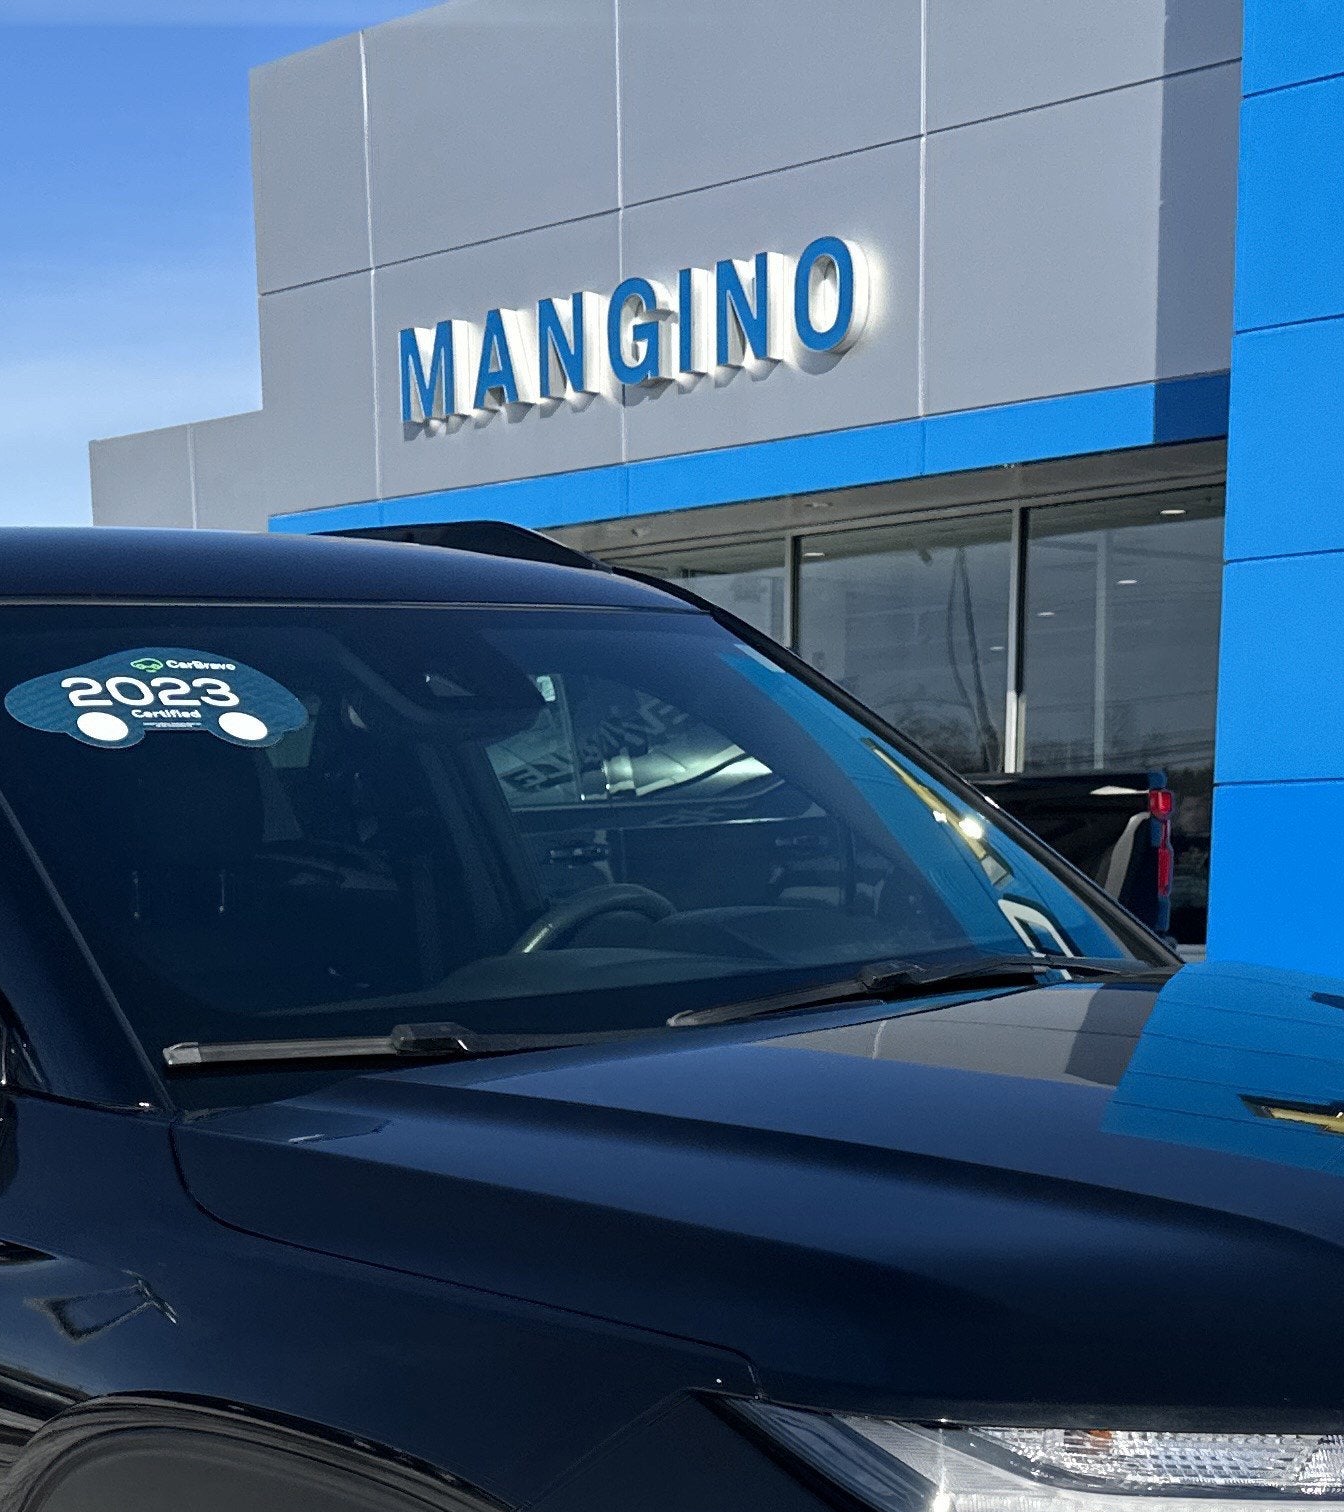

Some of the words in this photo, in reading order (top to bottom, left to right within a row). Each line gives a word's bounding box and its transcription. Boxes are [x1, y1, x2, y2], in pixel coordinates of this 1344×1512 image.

[399, 236, 856, 423] MANGINO
[165, 659, 236, 671] CarBravo
[61, 676, 240, 707] 2023
[131, 709, 202, 719] Certified
